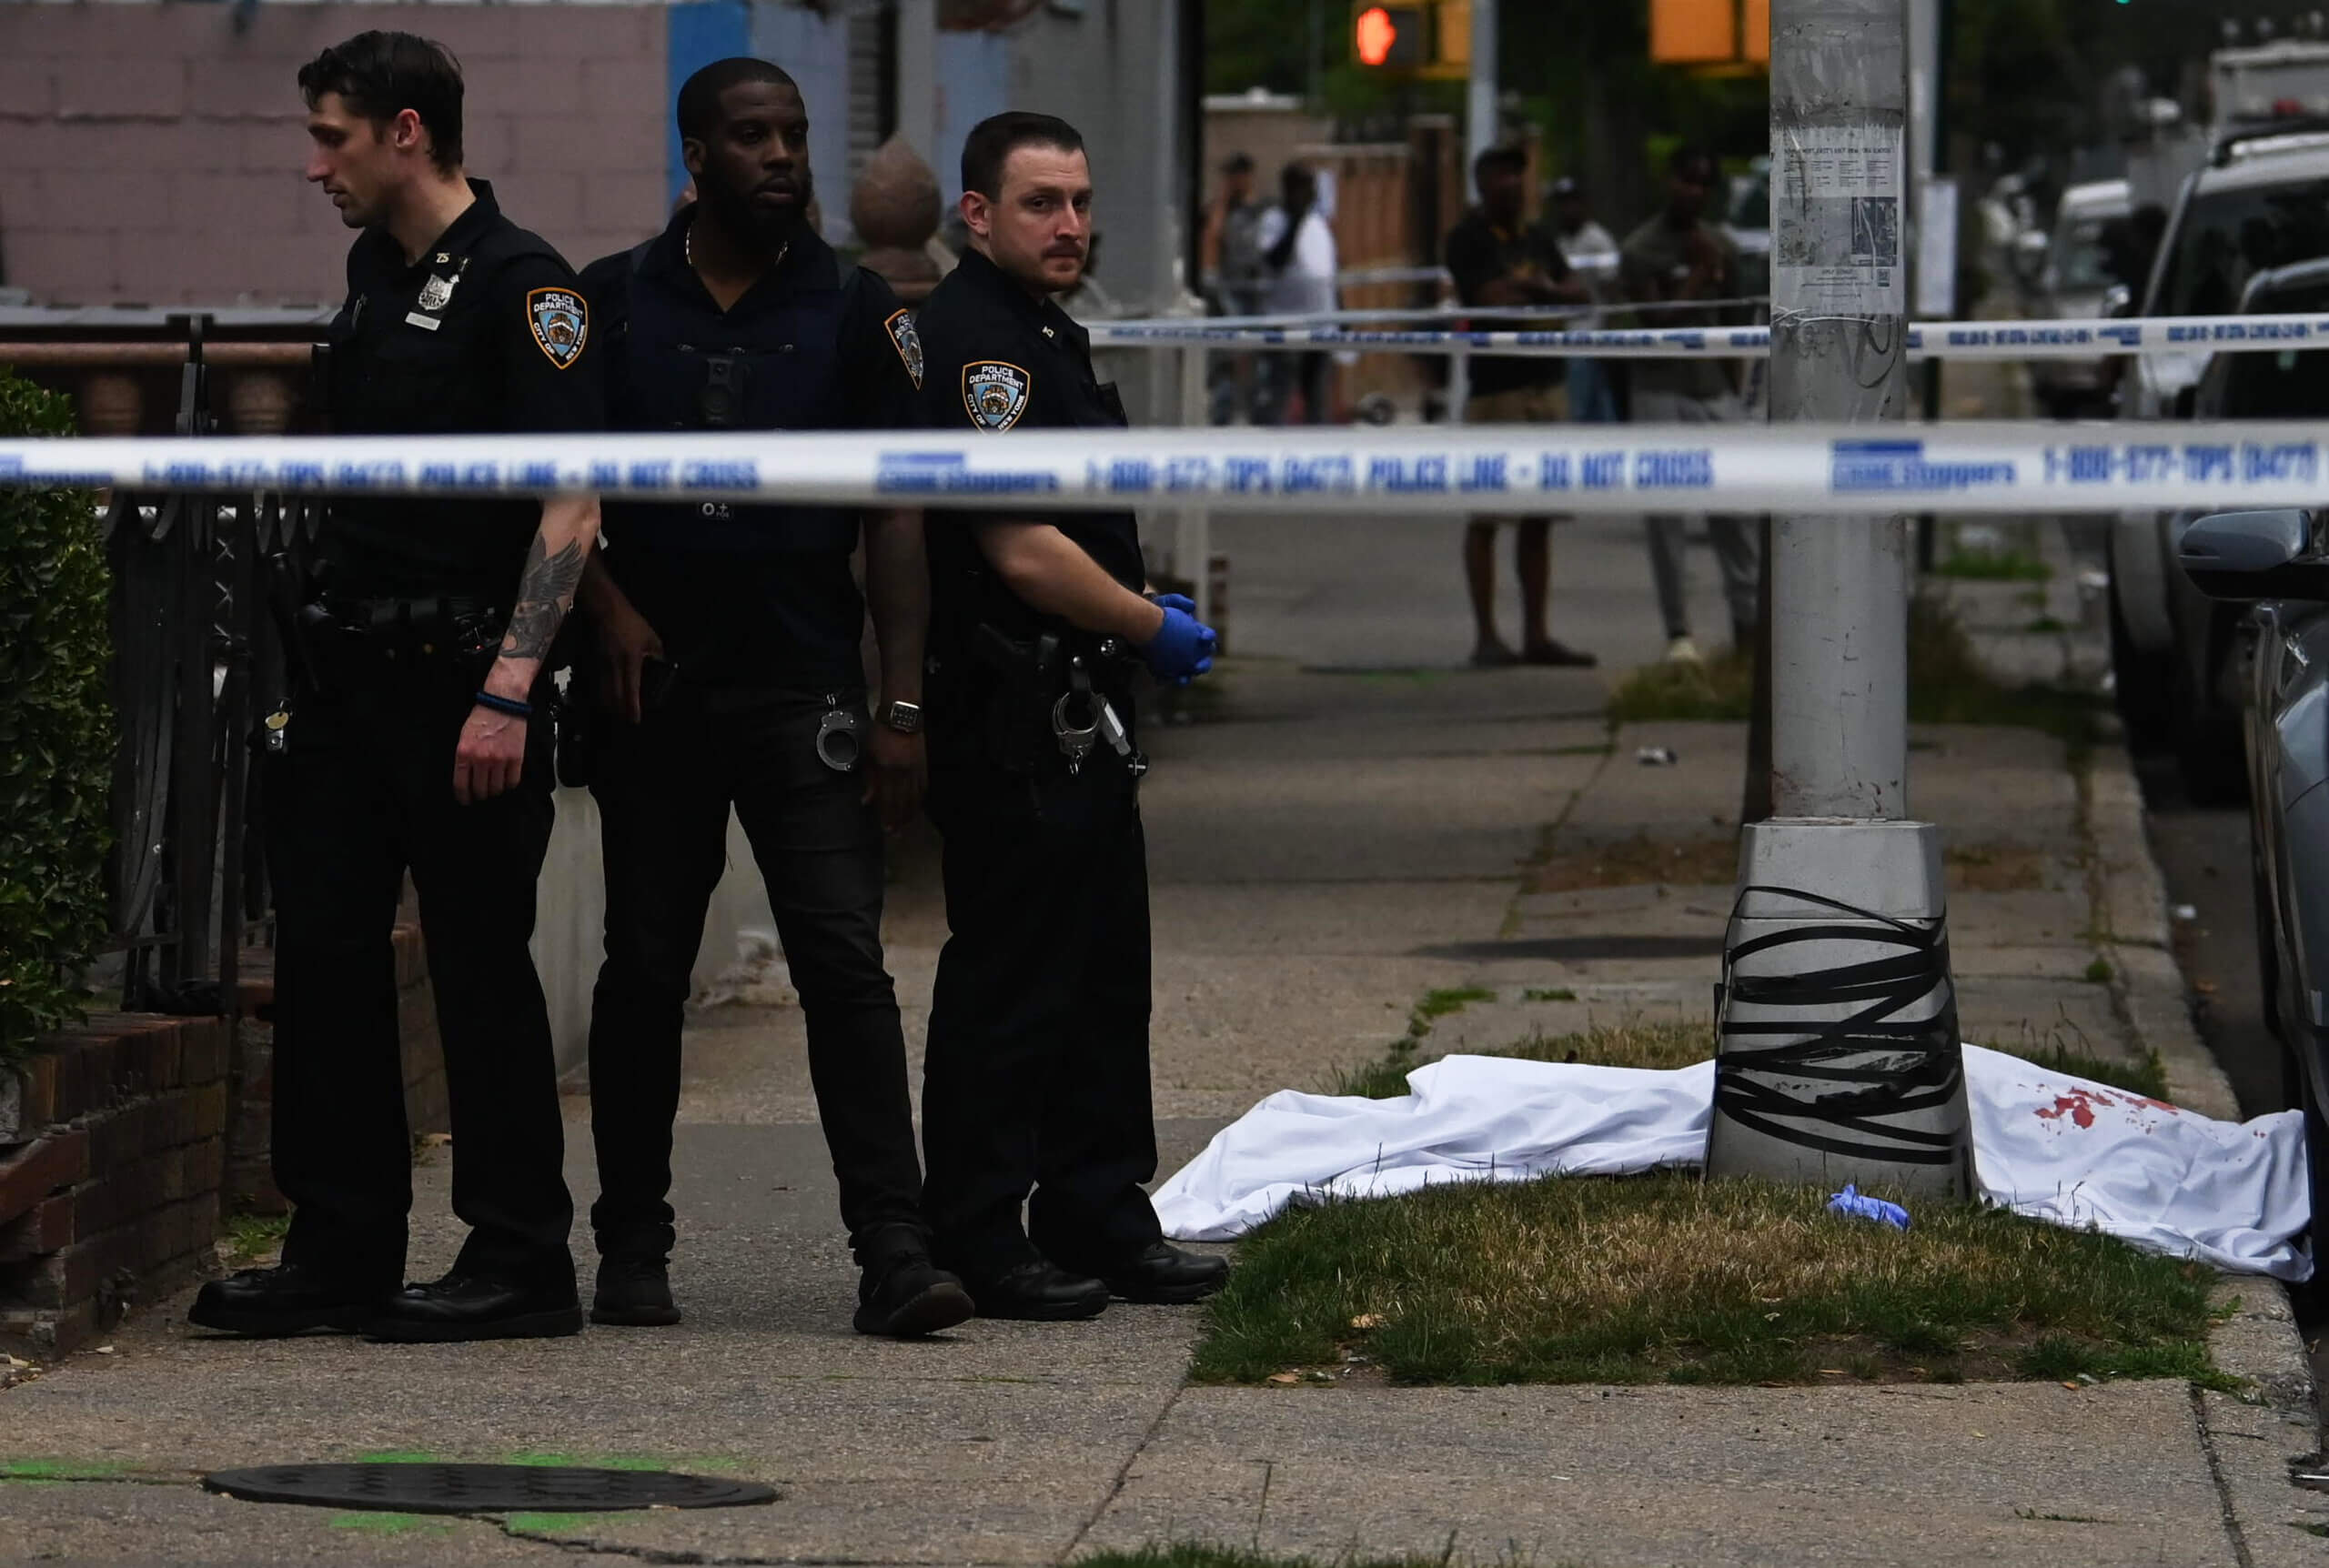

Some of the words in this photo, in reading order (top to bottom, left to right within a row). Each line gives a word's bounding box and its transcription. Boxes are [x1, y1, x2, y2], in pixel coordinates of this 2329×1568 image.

[546, 294, 575, 307] POLICE
[533, 322, 547, 342] CITY
[969, 373, 1024, 390] DEPARTMENT
[982, 366, 1013, 377] POLICE
[967, 394, 980, 413] CITY
[976, 414, 986, 426] OF
[998, 416, 1013, 430] NEW
[1010, 394, 1025, 415] YORK
[1636, 451, 1714, 488] CROSS
